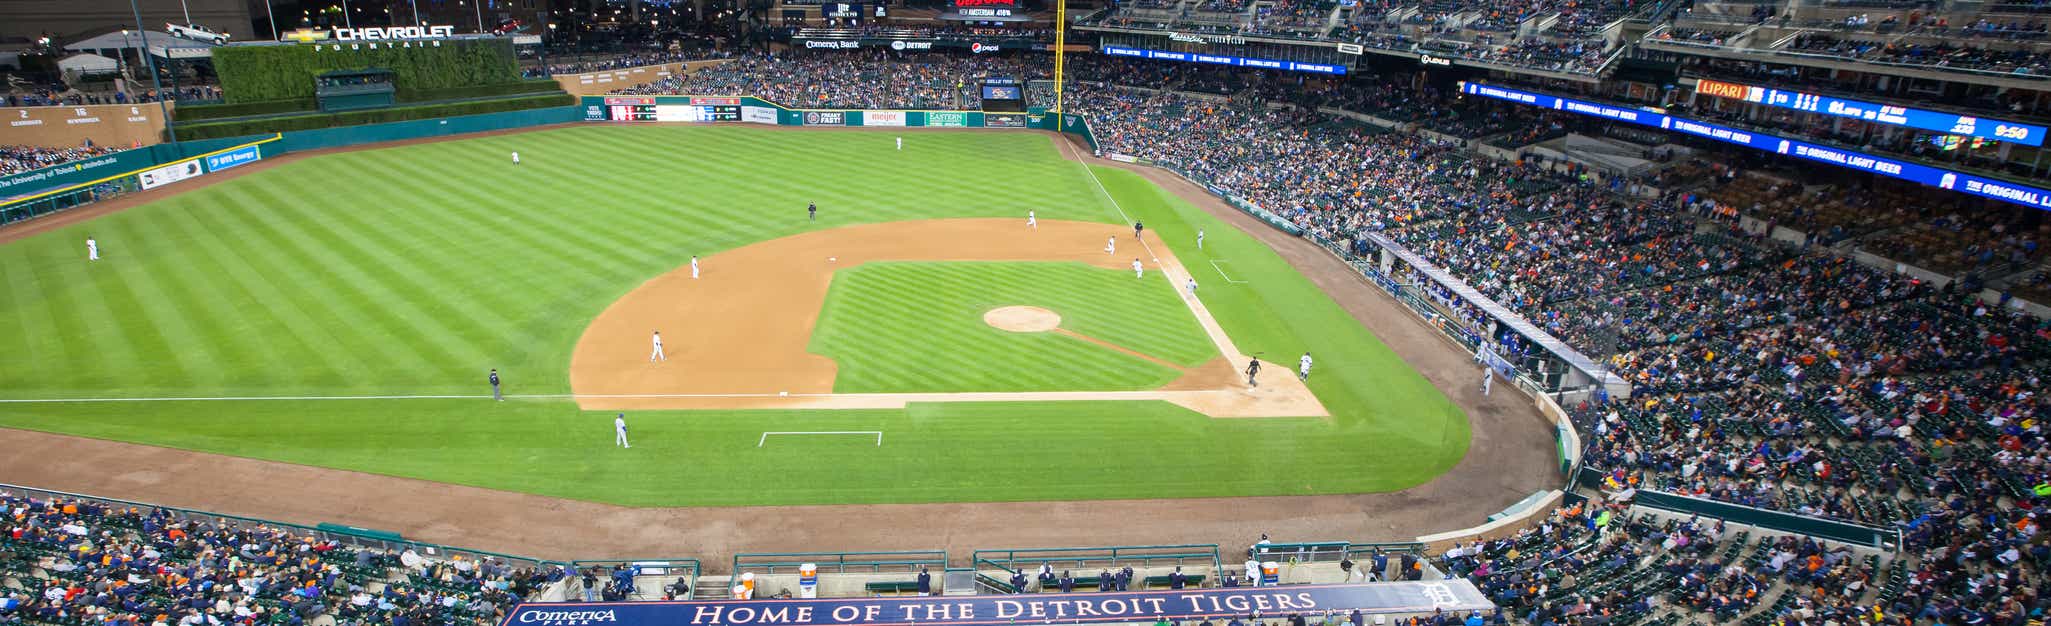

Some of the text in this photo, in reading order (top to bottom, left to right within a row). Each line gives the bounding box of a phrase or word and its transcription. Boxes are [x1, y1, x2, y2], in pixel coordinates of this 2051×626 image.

[336, 26, 454, 40] CHEVROLET
[315, 40, 440, 51] FOUNTAIN
[806, 41, 839, 49] Comerica
[1703, 82, 1742, 99] LIPARI
[20, 110, 28, 118] 2
[872, 113, 896, 121] meijer
[930, 112, 962, 120] EASTERN
[1575, 104, 1600, 114] ORIGINAL
[1601, 109, 1619, 117] LIGHT
[1683, 122, 1711, 135] ORIGINAL
[1711, 129, 1731, 138] LIGHT
[1731, 132, 1751, 143] BEER
[233, 150, 254, 161] Energy
[1807, 147, 1845, 163] ORIGINAL
[1847, 156, 1875, 168] LIGHT
[1874, 160, 1901, 174] BEER
[11, 173, 46, 185] University
[55, 166, 76, 175] Toledo
[1965, 181, 1982, 191] THE
[1982, 183, 2038, 203] ORIGINAL
[691, 592, 1317, 625] HOME OF THE DETROIT TIGERS
[520, 609, 616, 623] Comerica
